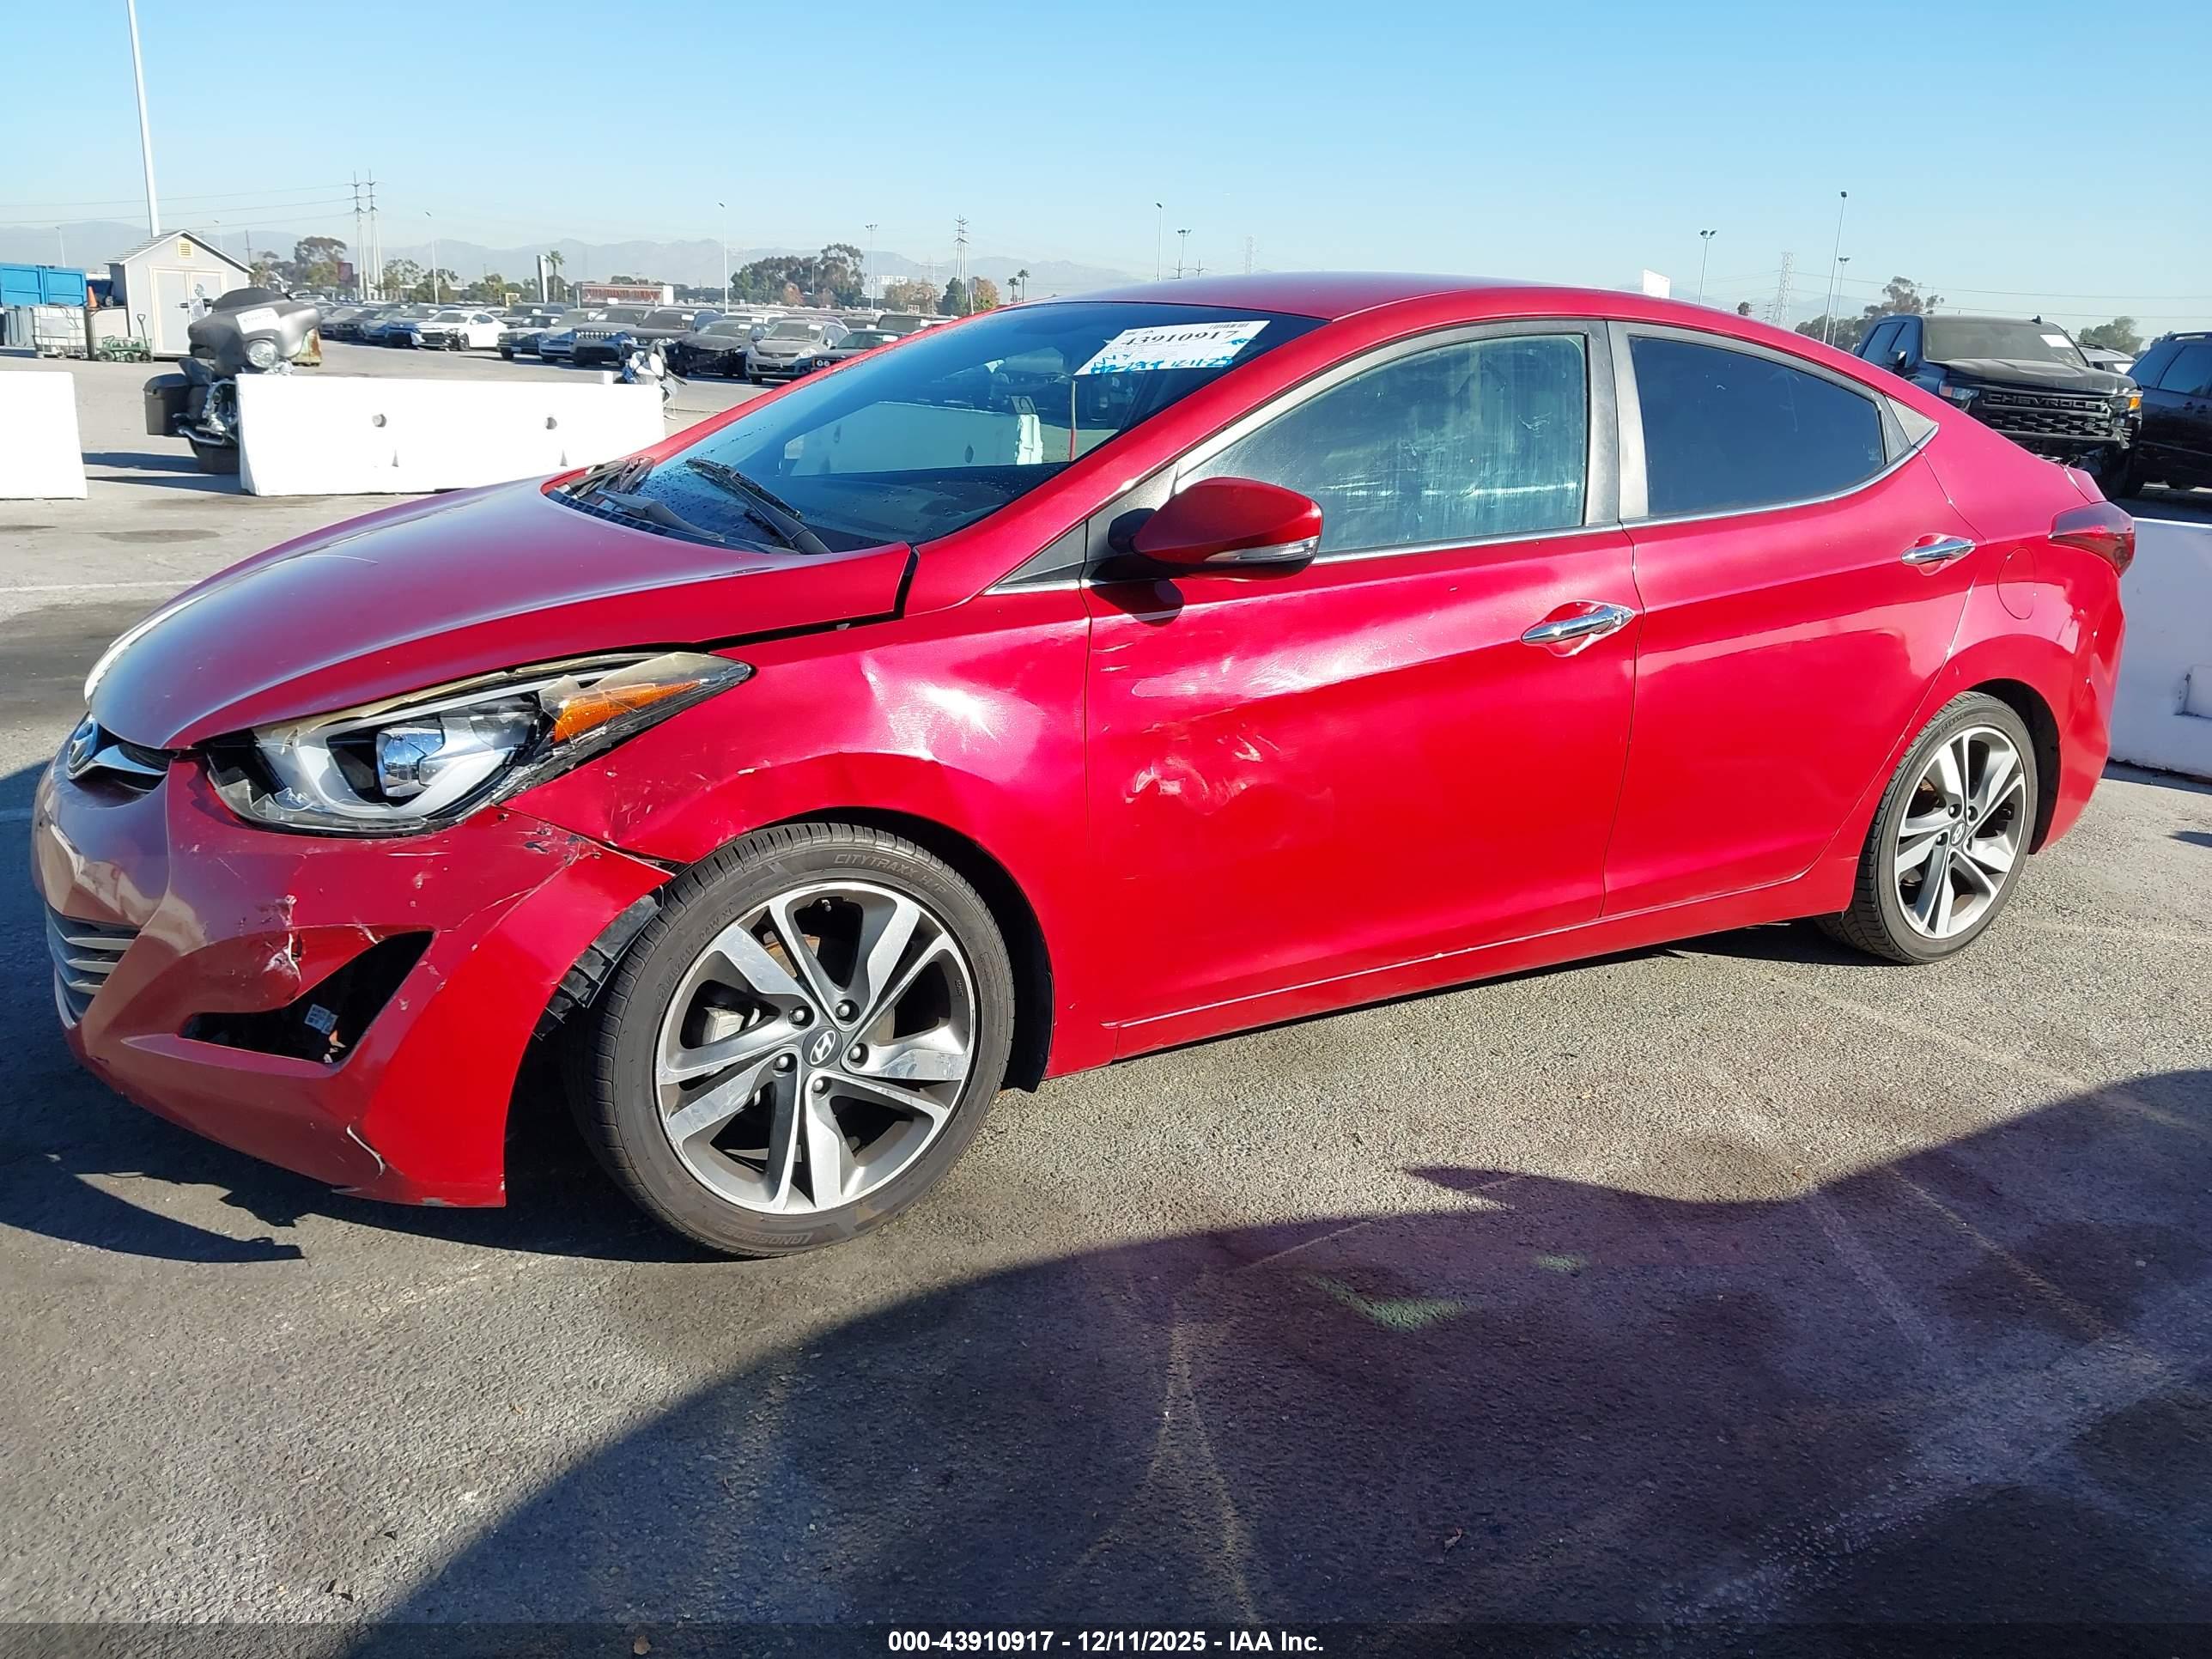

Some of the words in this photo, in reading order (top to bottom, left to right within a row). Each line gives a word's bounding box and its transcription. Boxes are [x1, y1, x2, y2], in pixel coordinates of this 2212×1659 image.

[1121, 330, 1239, 346] 43910917
[1987, 392, 2107, 412] CHEVROLET
[833, 853, 918, 878] CITYTRAXX
